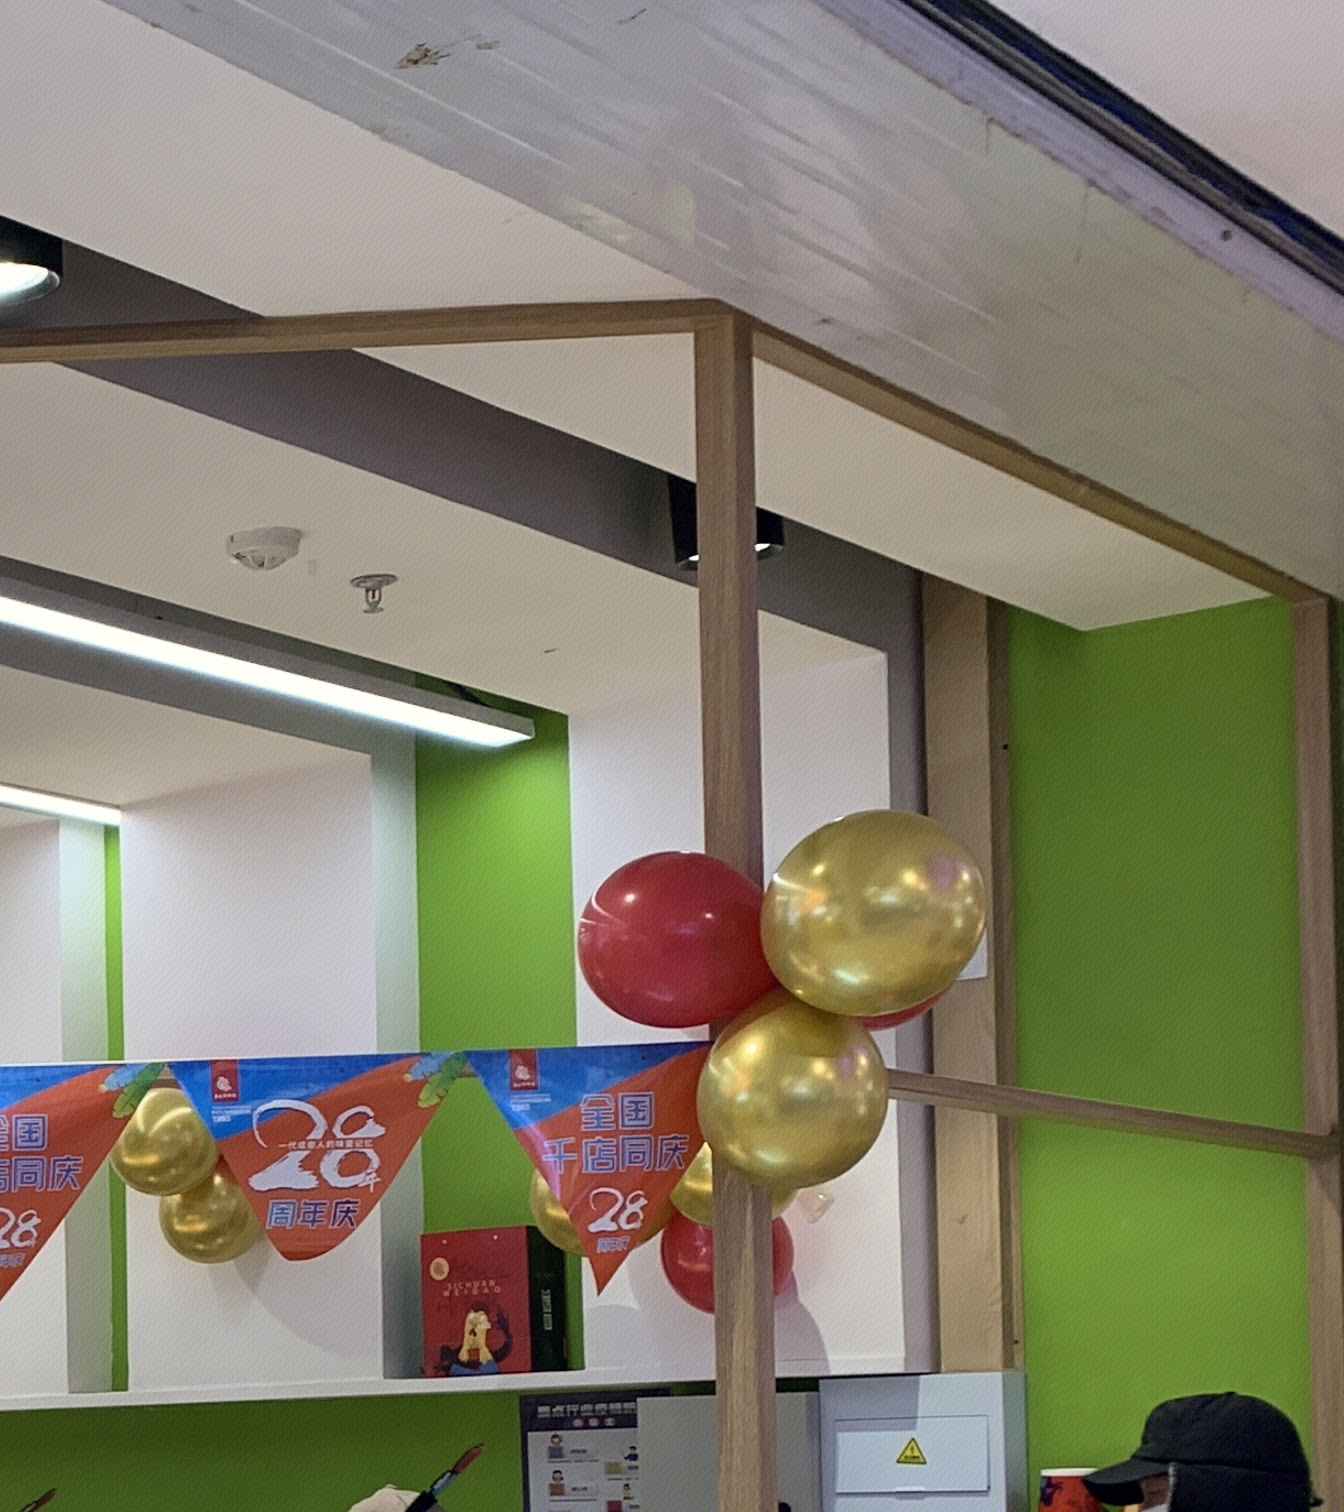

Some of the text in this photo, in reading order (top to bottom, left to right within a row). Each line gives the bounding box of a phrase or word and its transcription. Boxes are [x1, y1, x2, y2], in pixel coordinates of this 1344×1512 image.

[579, 1091, 655, 1131] 全国
[542, 1133, 690, 1174] 千店同庆
[265, 1198, 361, 1230] 周年庆
